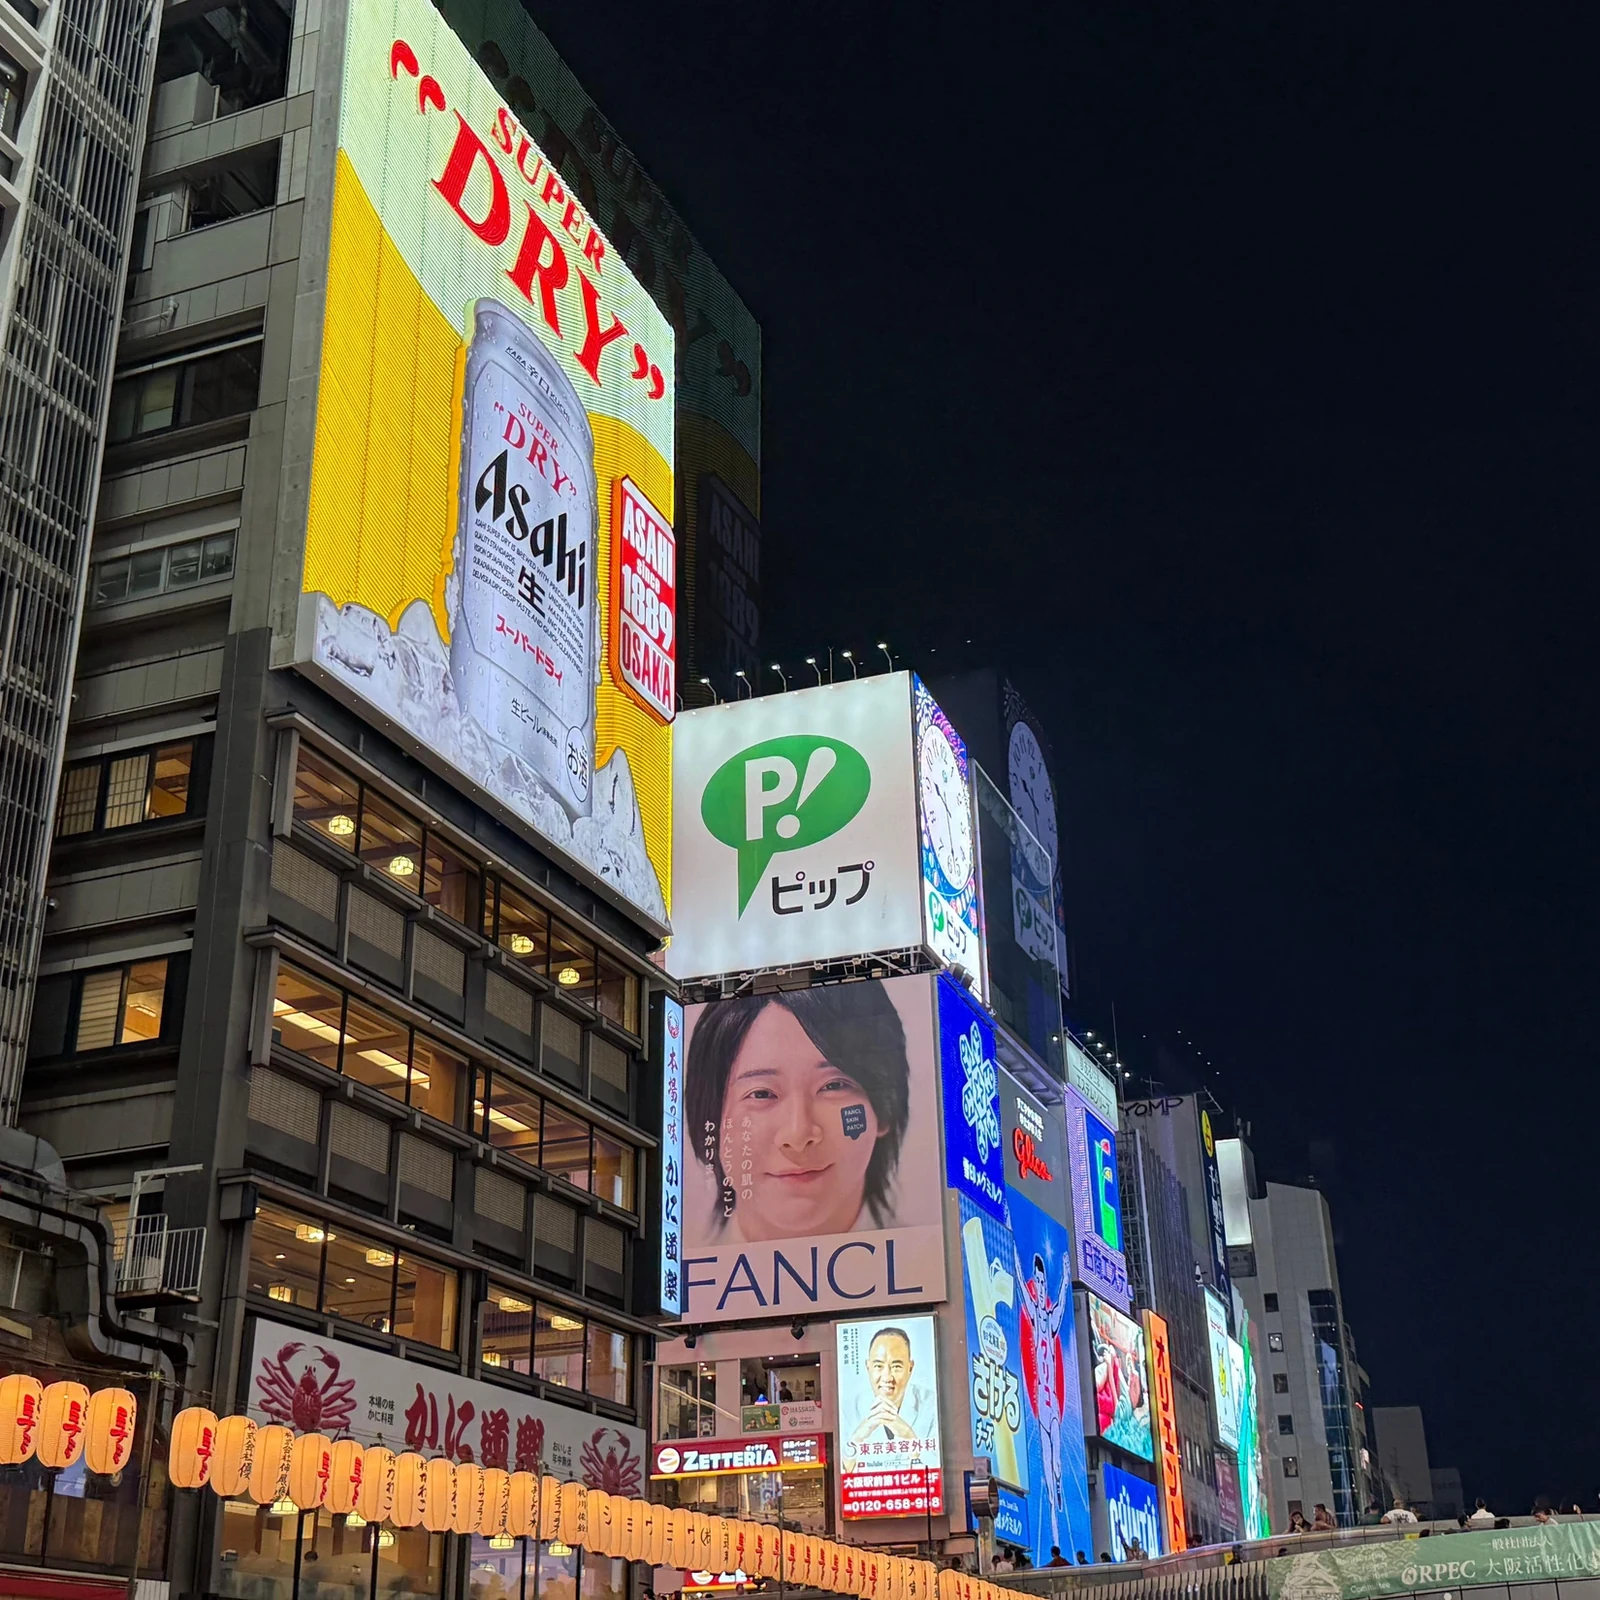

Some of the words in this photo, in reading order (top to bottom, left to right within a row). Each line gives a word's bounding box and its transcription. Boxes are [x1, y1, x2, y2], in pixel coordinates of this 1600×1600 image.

[491, 107, 605, 276] SUPER
[505, 346, 527, 370] KARA
[517, 400, 559, 457] SUPER
[475, 449, 586, 610] Asahi
[486, 524, 500, 540] SUPER
[500, 534, 512, 548] DRY
[516, 548, 536, 570] BREWED
[536, 566, 549, 584] WITH
[623, 494, 673, 588] ASAHI
[517, 565, 546, 619] 生
[636, 557, 661, 593] since
[501, 588, 518, 604] CRISP
[516, 598, 532, 618] TASTE
[531, 614, 543, 628] AND
[622, 562, 673, 651] 1889
[495, 614, 563, 687] スーパードライ
[622, 620, 672, 712] OSAKA
[510, 698, 542, 734] 生ビール
[771, 860, 876, 916] ピップ
[667, 1046, 680, 1146] 本場の味
[844, 1108, 862, 1116] FANCL
[722, 1118, 734, 1218] ほんとうのこと
[741, 1116, 753, 1200] あなたの肌の
[1013, 1128, 1053, 1182] Glico
[682, 1240, 924, 1314] FANCL
[368, 1395, 395, 1412] 本場の味
[368, 1408, 394, 1426] かに料理
[972, 1352, 1020, 1432] さける
[683, 1450, 778, 1472] ZETTERIA
[860, 1438, 936, 1456] 東京美容外科
[976, 1418, 994, 1453] チーズ
[1480, 1536, 1552, 1551] 一般社団法人
[1402, 1560, 1476, 1586] ORPEC
